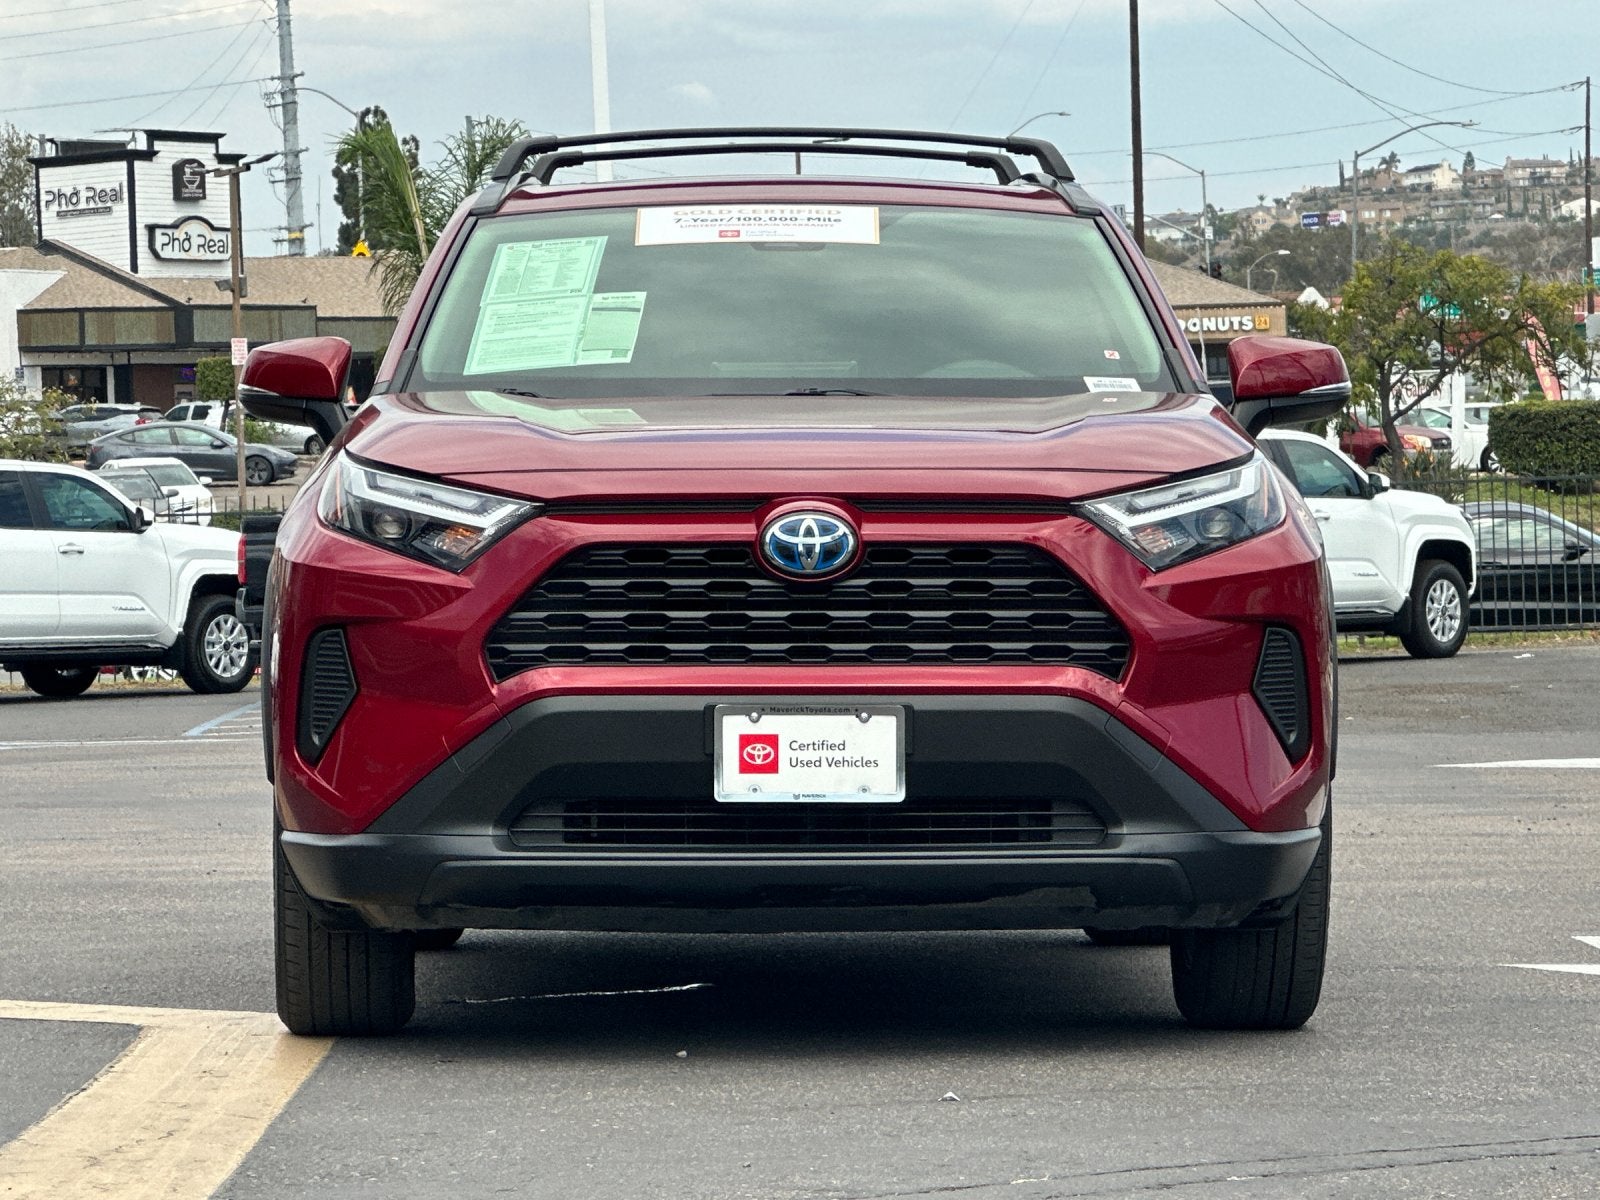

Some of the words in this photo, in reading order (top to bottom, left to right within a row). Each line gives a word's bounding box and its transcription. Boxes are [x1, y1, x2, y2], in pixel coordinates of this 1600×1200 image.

[85, 182, 124, 205] Real
[737, 208, 842, 216] CERTIFIED
[197, 233, 229, 254] Real
[769, 706, 851, 714] MaverickToyota.com
[788, 739, 846, 752] Certified
[789, 755, 822, 768] Used
[825, 755, 879, 768] Vehicles
